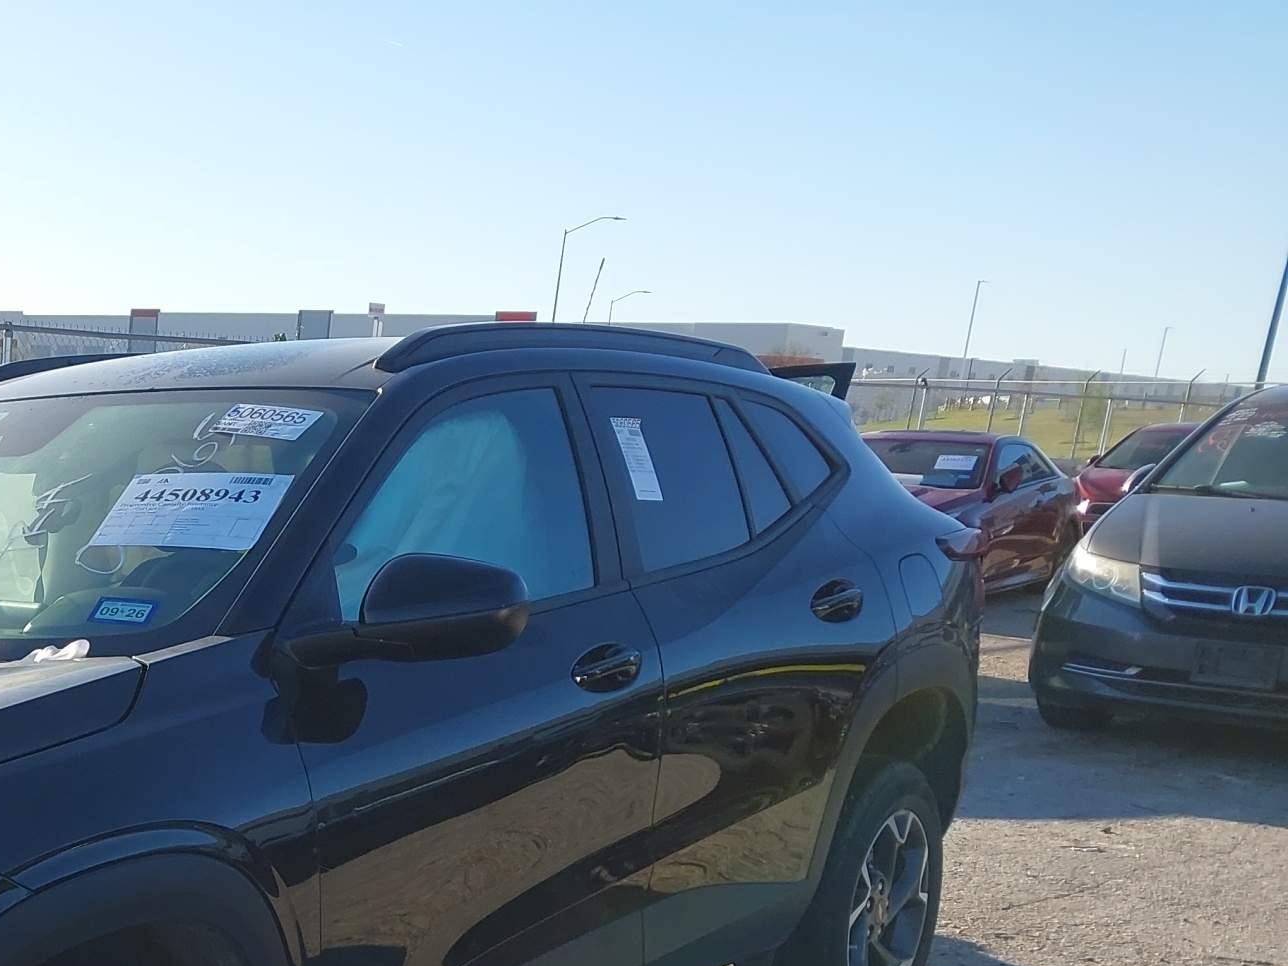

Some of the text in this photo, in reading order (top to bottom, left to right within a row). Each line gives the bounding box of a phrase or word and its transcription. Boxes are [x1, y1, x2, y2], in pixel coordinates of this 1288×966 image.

[227, 406, 312, 424] 5060565
[134, 488, 262, 504] 44508943
[99, 606, 147, 619] 09 26
